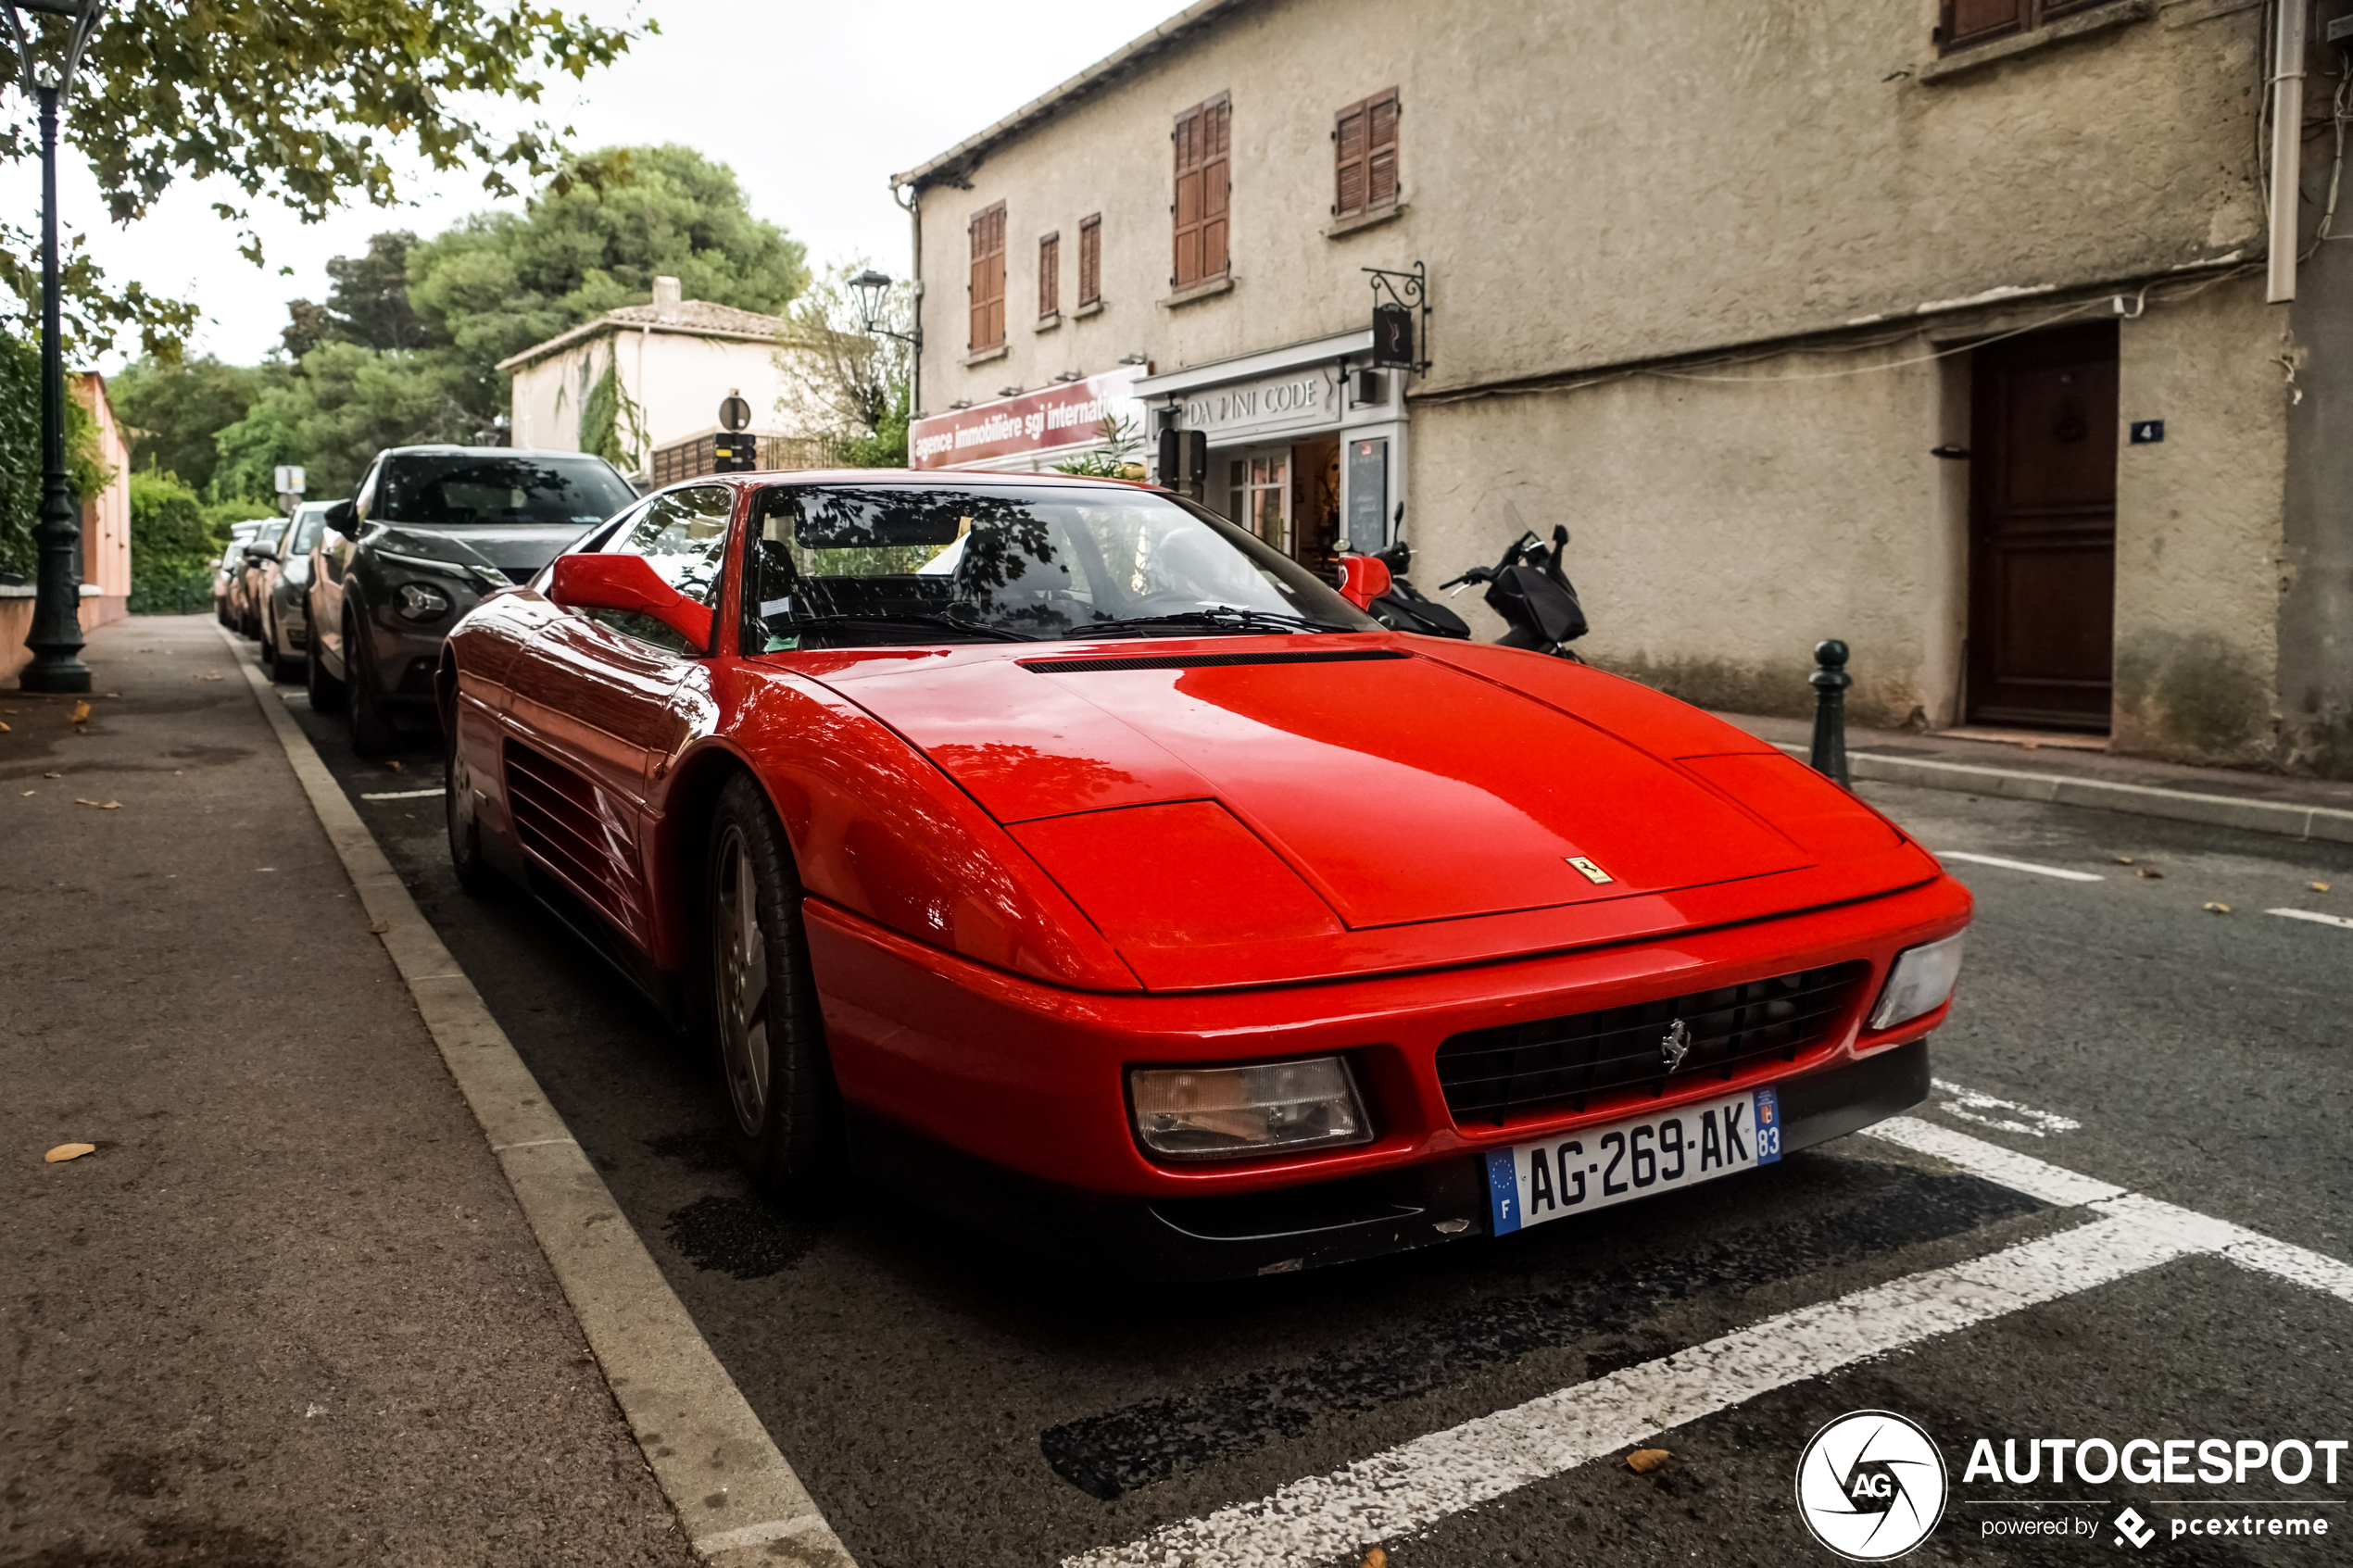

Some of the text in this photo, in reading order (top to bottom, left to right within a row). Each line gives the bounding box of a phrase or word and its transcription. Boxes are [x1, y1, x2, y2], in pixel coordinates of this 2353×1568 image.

[1189, 400, 1213, 426] DA
[1264, 379, 1316, 413] CODE
[916, 432, 953, 461] agence
[955, 413, 1023, 449] immobilière
[1025, 404, 1045, 440] sgi
[2141, 424, 2152, 439] 4
[1757, 1126, 1780, 1157] 83
[1501, 1198, 1511, 1220] F
